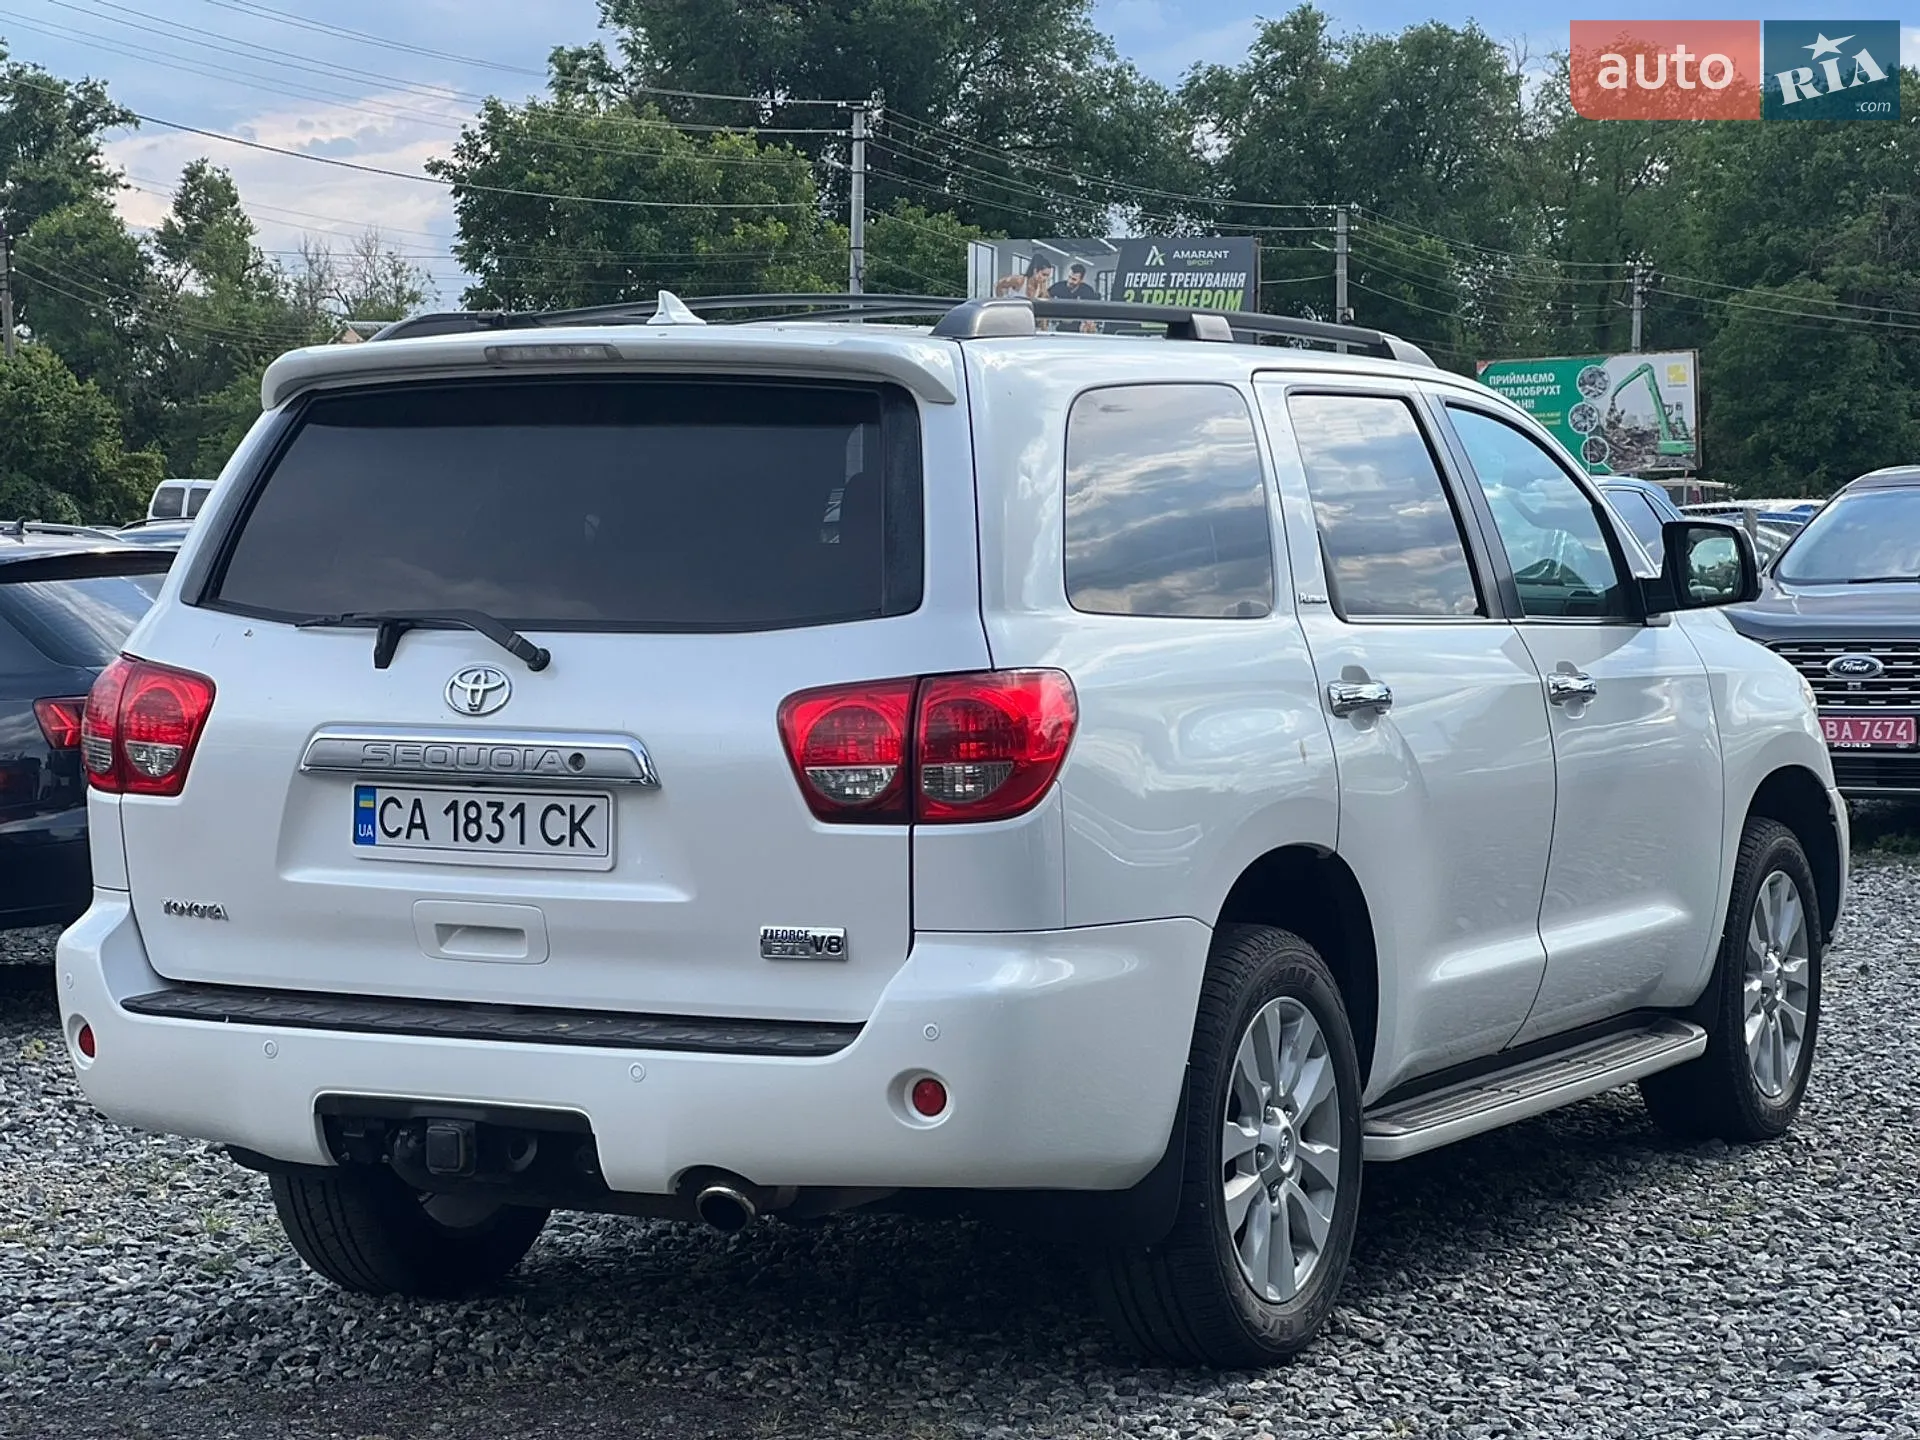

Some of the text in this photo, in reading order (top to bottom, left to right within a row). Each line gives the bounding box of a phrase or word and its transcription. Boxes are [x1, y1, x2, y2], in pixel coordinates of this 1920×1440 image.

[1172, 250, 1230, 260] AMARANT
[1124, 272, 1247, 288] ПЕРШЕ ТРЕНУВАННЯ
[1141, 289, 1244, 312] ТРЕНЕРОМ
[1489, 372, 1555, 385] ПРИЙМАЄМО
[1493, 384, 1561, 397] ЕТАЛОБРУХТ
[1840, 660, 1870, 672] Ford
[1825, 721, 1907, 740] BA 7674
[361, 743, 567, 773] SEQUOIA
[358, 823, 374, 837] UA
[379, 796, 597, 849] CA 1831 CK
[161, 899, 229, 921] TOYOTA
[811, 934, 844, 955] V8
